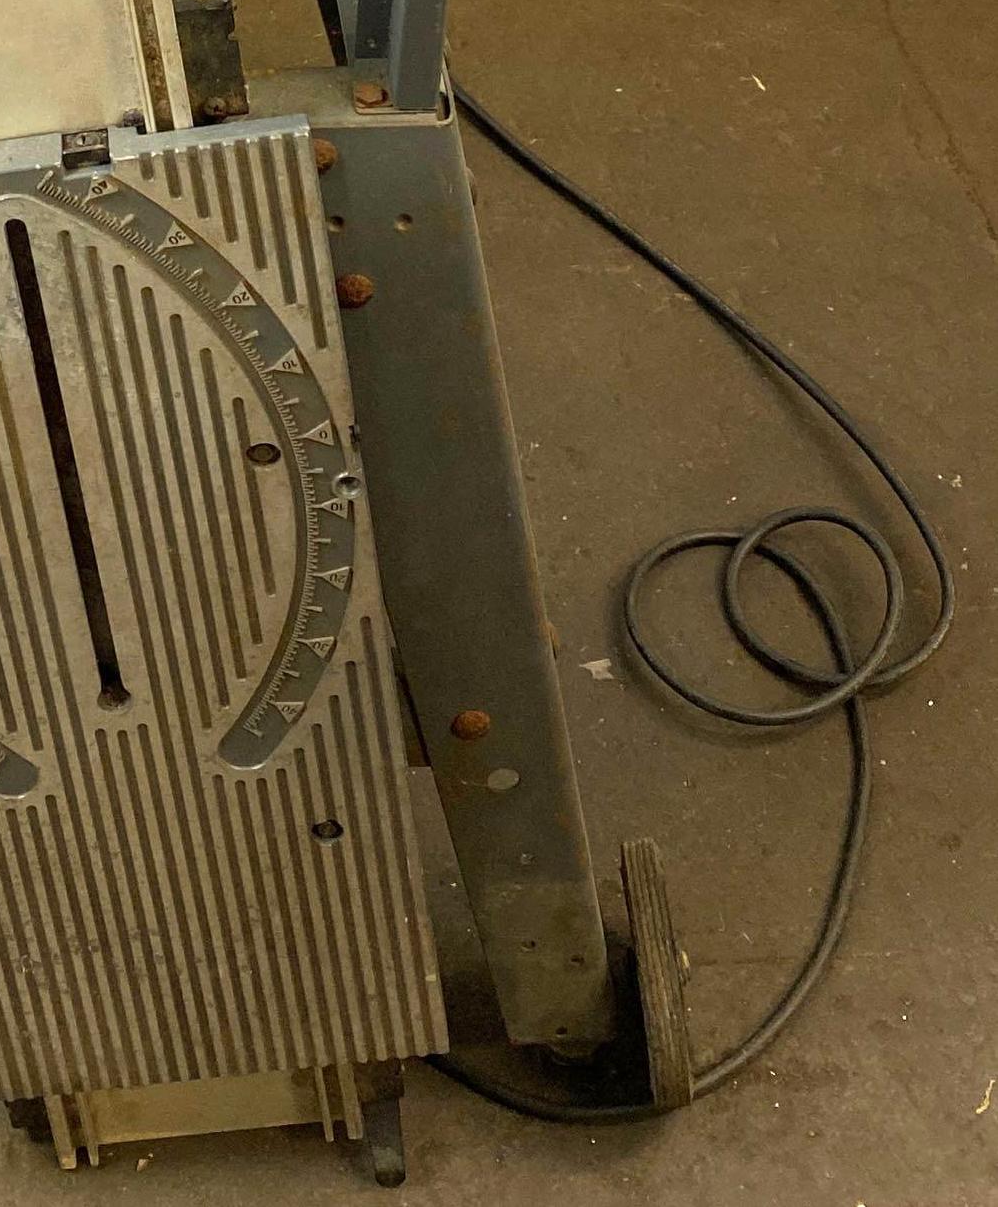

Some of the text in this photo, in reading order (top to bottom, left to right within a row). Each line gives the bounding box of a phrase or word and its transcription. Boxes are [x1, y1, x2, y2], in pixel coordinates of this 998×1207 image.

[91, 180, 108, 194] 40
[168, 230, 186, 244] 30
[232, 291, 250, 304] 20
[282, 360, 299, 370] 10
[330, 502, 343, 512] 10
[329, 573, 345, 584] 20
[313, 639, 328, 651] 30
